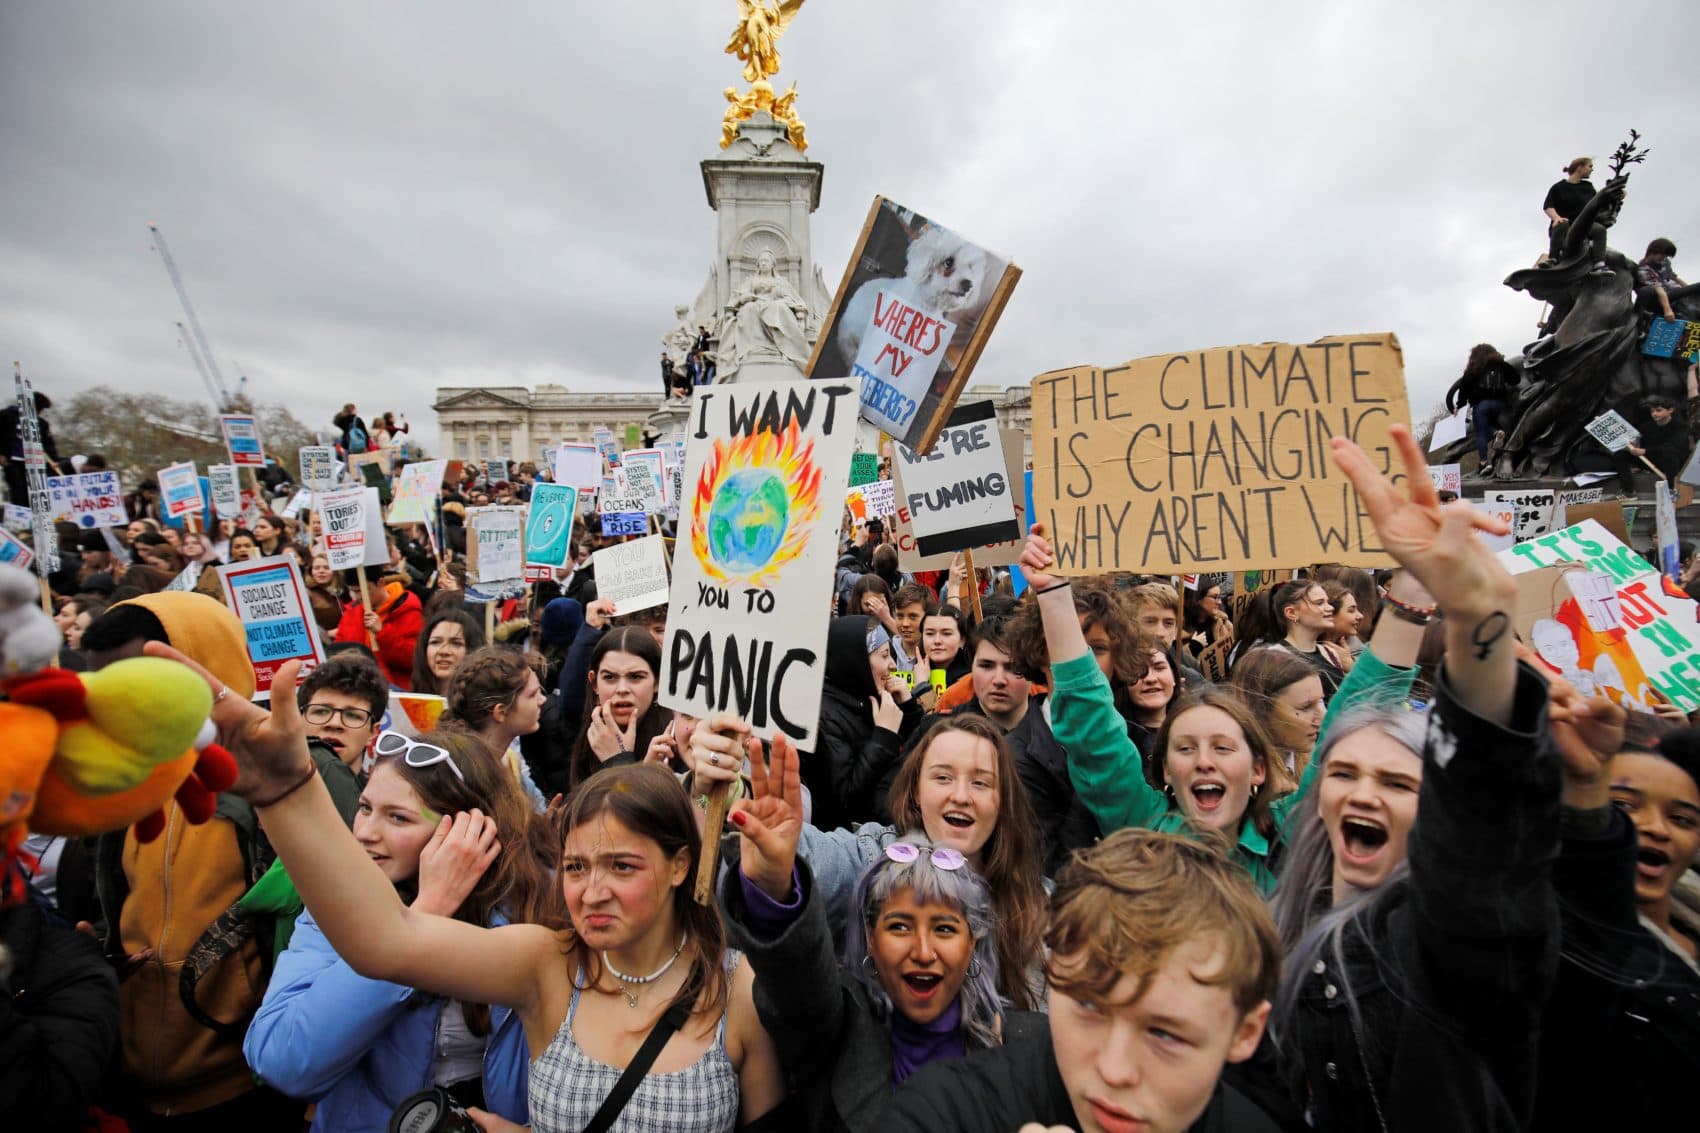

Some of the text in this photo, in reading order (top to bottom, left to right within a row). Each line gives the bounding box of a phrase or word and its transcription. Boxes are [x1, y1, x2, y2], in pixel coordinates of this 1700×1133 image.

[873, 292, 947, 356] WHERE'S
[875, 343, 913, 378] MY
[1039, 342, 1387, 428] THE CLIMATE
[694, 385, 854, 439] I WANT
[1052, 407, 1391, 500] IS CHANGING
[326, 503, 358, 520] TORIES
[603, 498, 645, 512] OCEANS
[908, 472, 1006, 518] FUMING
[330, 518, 349, 532] OUT
[610, 520, 643, 533] RISE
[1051, 501, 1132, 570] WHY
[1141, 487, 1286, 567] AREN'T
[609, 542, 645, 568] YOU
[241, 583, 288, 604] SOCIALIST
[250, 600, 288, 619] CHANGE
[697, 581, 775, 614] YOU TO
[246, 620, 305, 642] NOT CLIMATE
[1640, 617, 1693, 658] IN
[260, 639, 298, 657] CHANGE
[668, 628, 817, 739] PANIC
